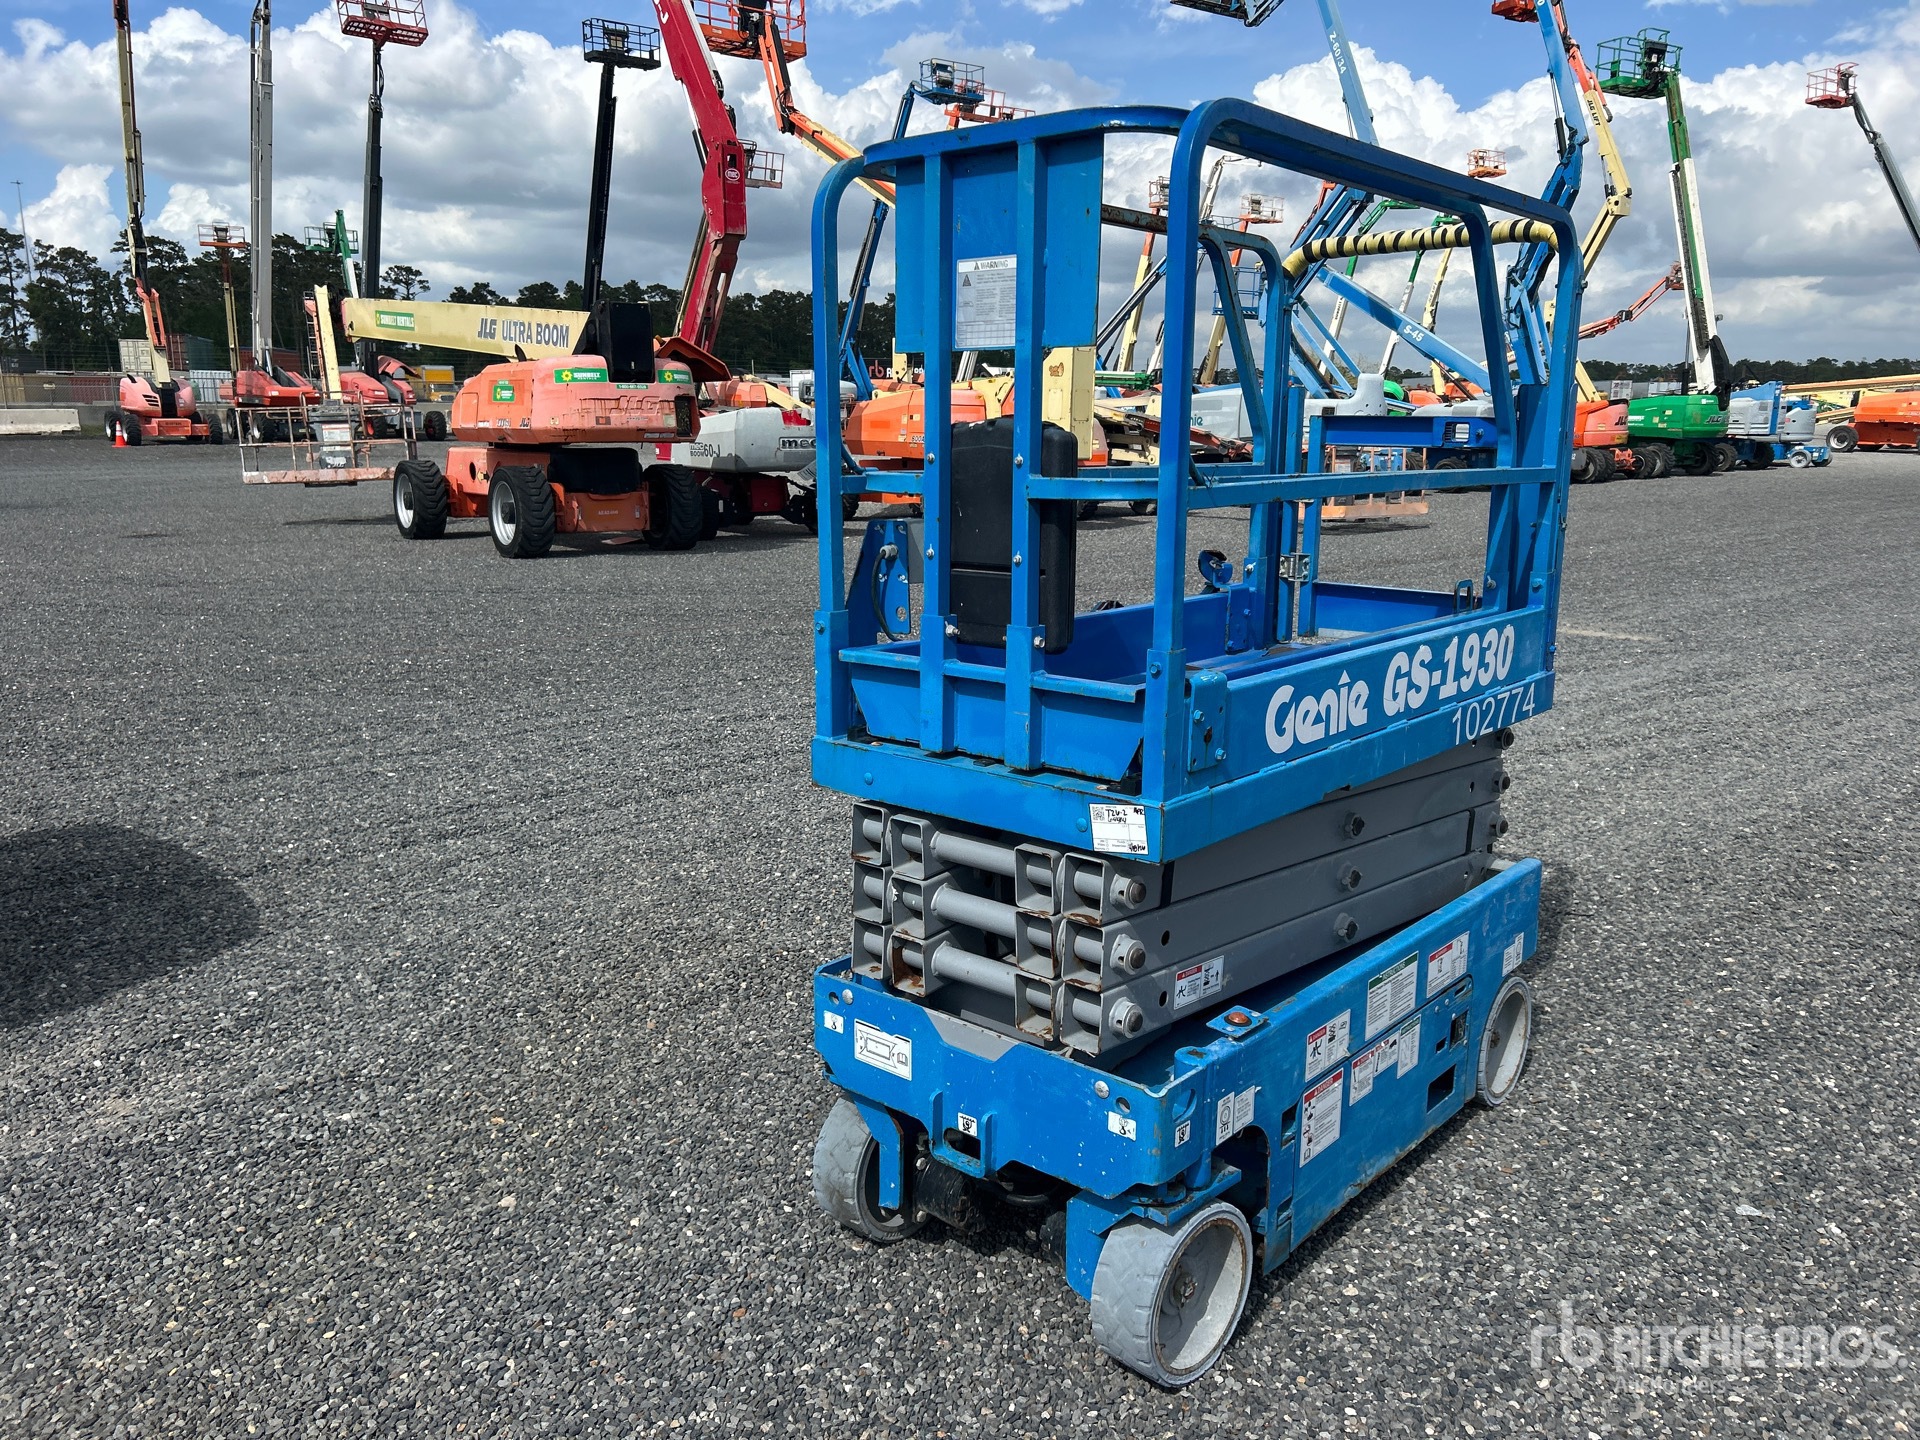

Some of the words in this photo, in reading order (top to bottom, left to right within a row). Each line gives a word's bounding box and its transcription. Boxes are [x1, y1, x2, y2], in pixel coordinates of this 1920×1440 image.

[1329, 31, 1347, 74] Z-60/34
[980, 259, 1009, 270] WARNING
[477, 317, 498, 340] JLG
[501, 319, 533, 345] ULTRA
[535, 322, 570, 348] BOOM
[1403, 324, 1425, 342] S-45
[610, 395, 661, 415] JLG
[703, 443, 721, 458] 60-J
[1265, 670, 1370, 754] Genie
[1383, 624, 1515, 717] GS-1930
[1452, 683, 1536, 746] 102774
